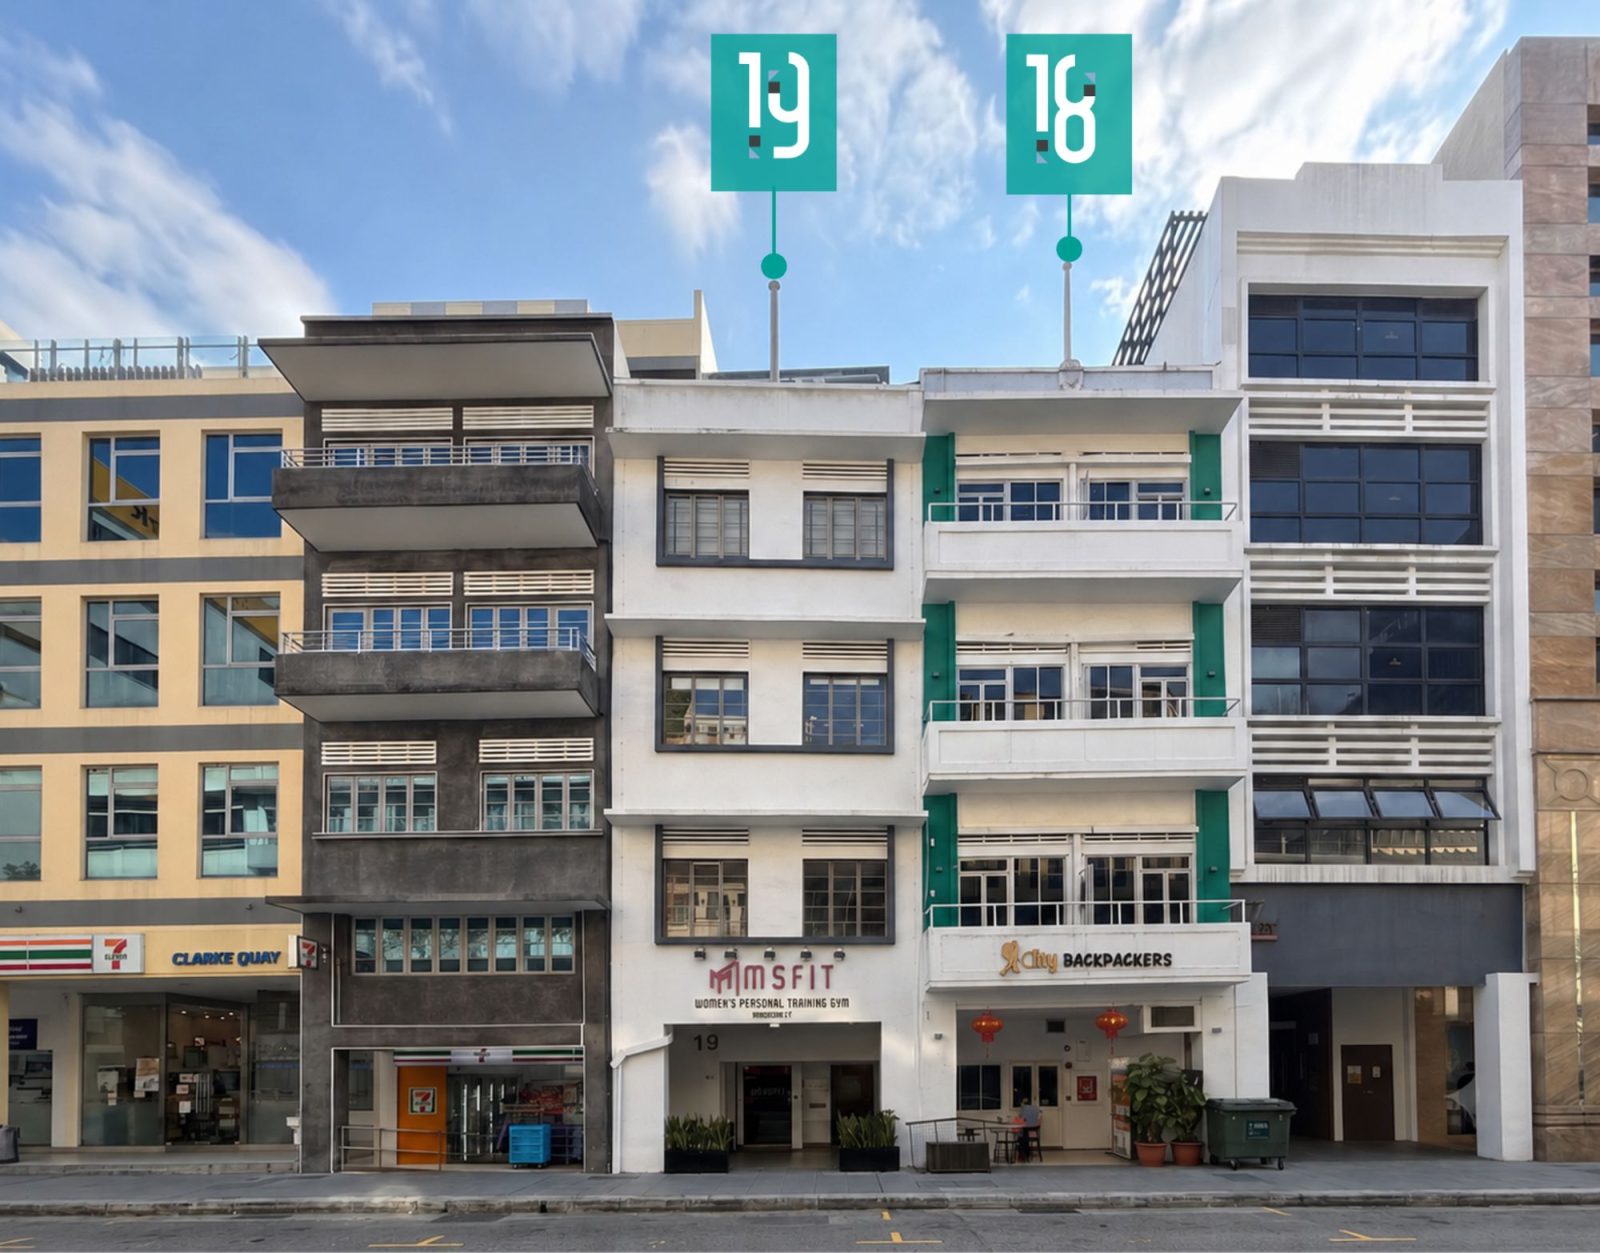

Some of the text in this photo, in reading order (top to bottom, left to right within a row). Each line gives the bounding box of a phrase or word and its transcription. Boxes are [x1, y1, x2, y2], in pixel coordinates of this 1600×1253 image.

[172, 951, 282, 967] CLARKE QUAY
[1063, 953, 1173, 968] BACKPACKERS
[695, 998, 849, 1008] WOMEN'S PERSONAL TRAINING GYM
[694, 1034, 718, 1051] 19
